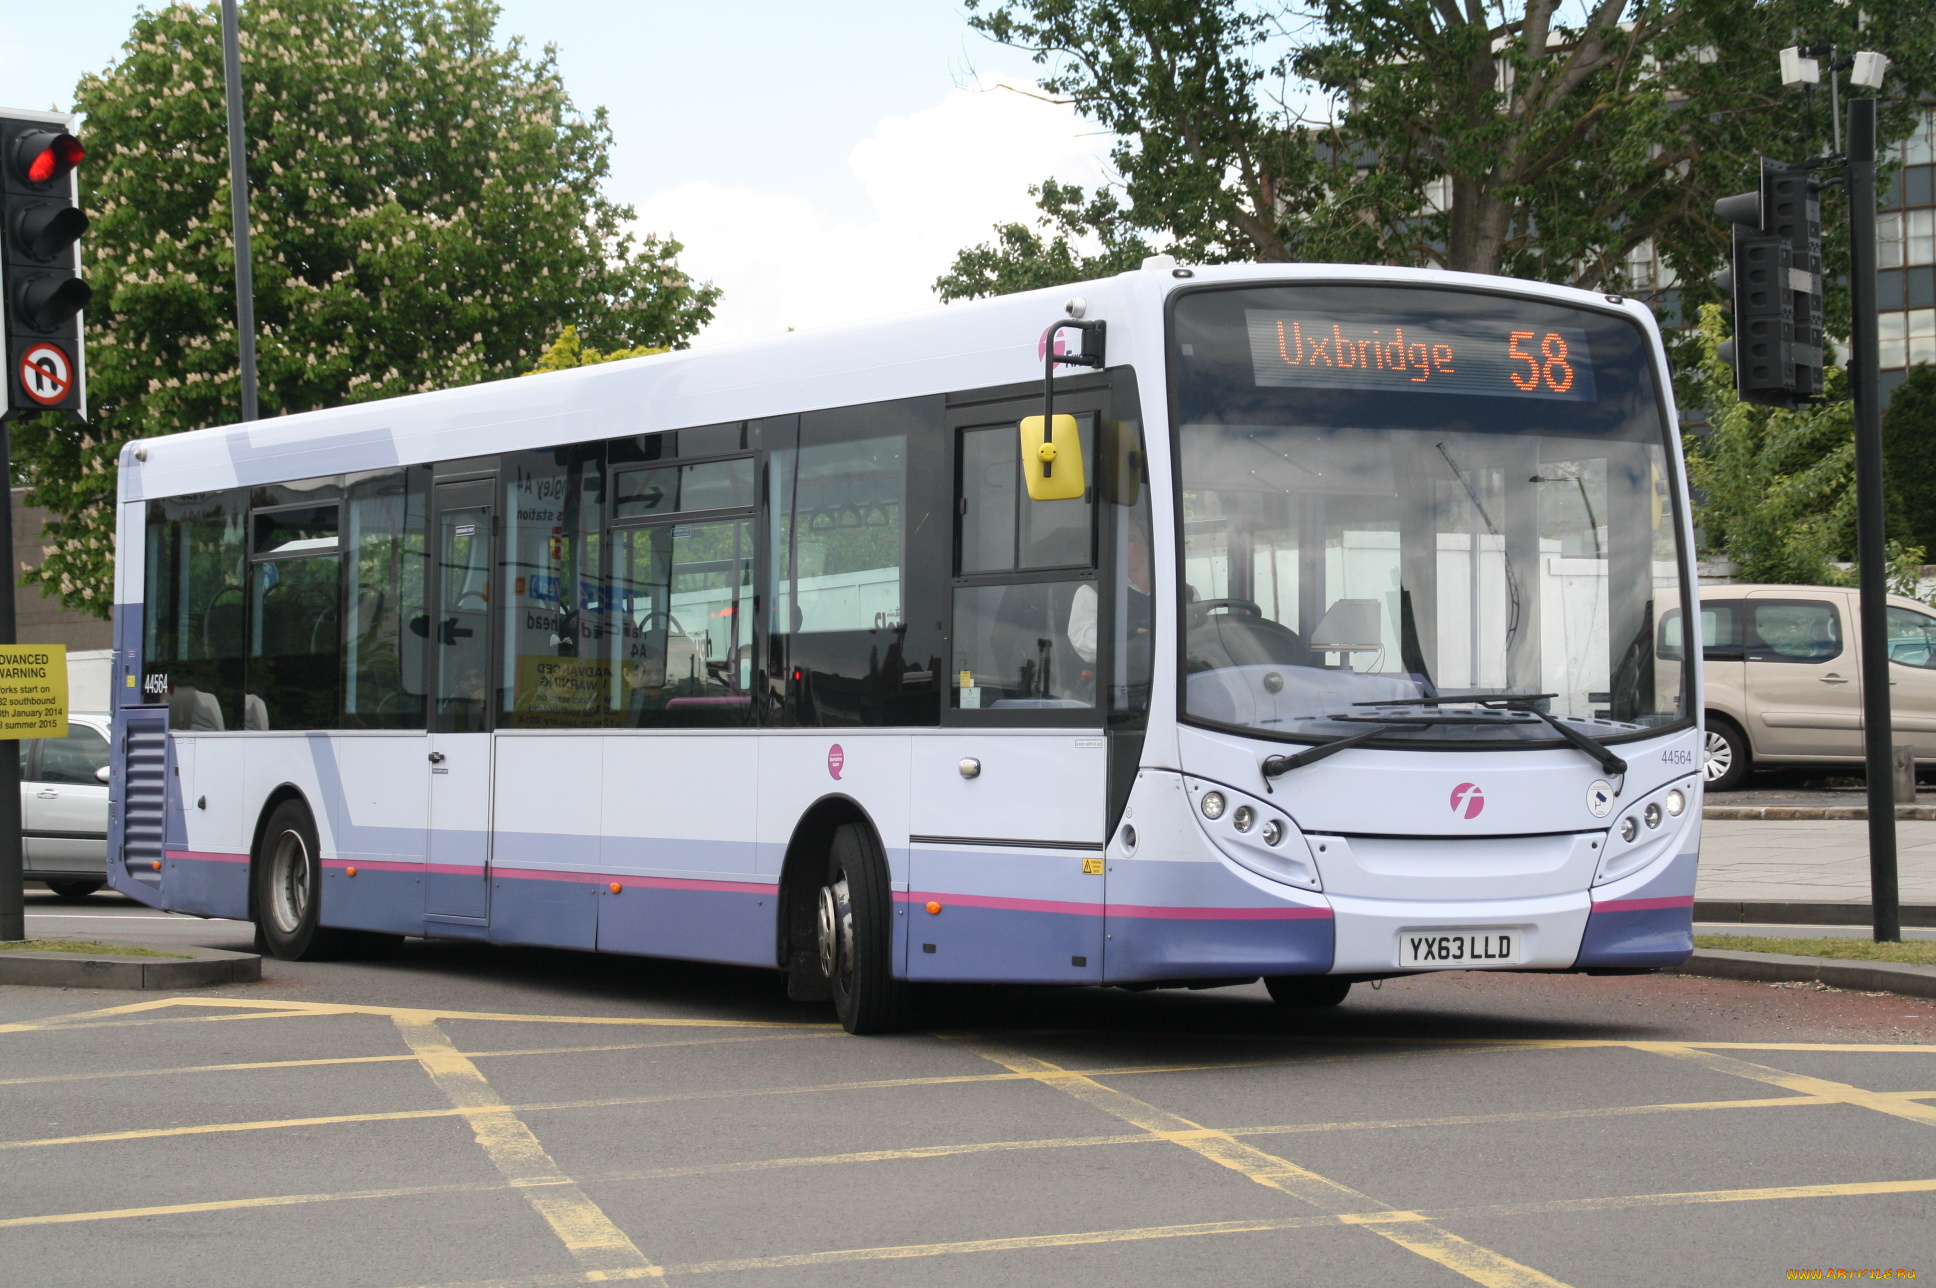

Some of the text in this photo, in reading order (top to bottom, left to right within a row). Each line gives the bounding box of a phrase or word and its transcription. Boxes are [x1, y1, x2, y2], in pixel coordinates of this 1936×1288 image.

[1277, 321, 1573, 392] Uxbridge 58
[0, 654, 49, 665] DVANCED
[144, 673, 168, 694] 44564
[0, 686, 18, 694] orks
[20, 685, 39, 694] start
[9, 696, 56, 706] southbound
[11, 709, 43, 719] January
[44, 708, 63, 717] 2014
[5, 721, 37, 730] summer
[38, 719, 57, 728] 2015
[1661, 750, 1692, 765] 44564
[1410, 935, 1511, 961] YX63 LLD
